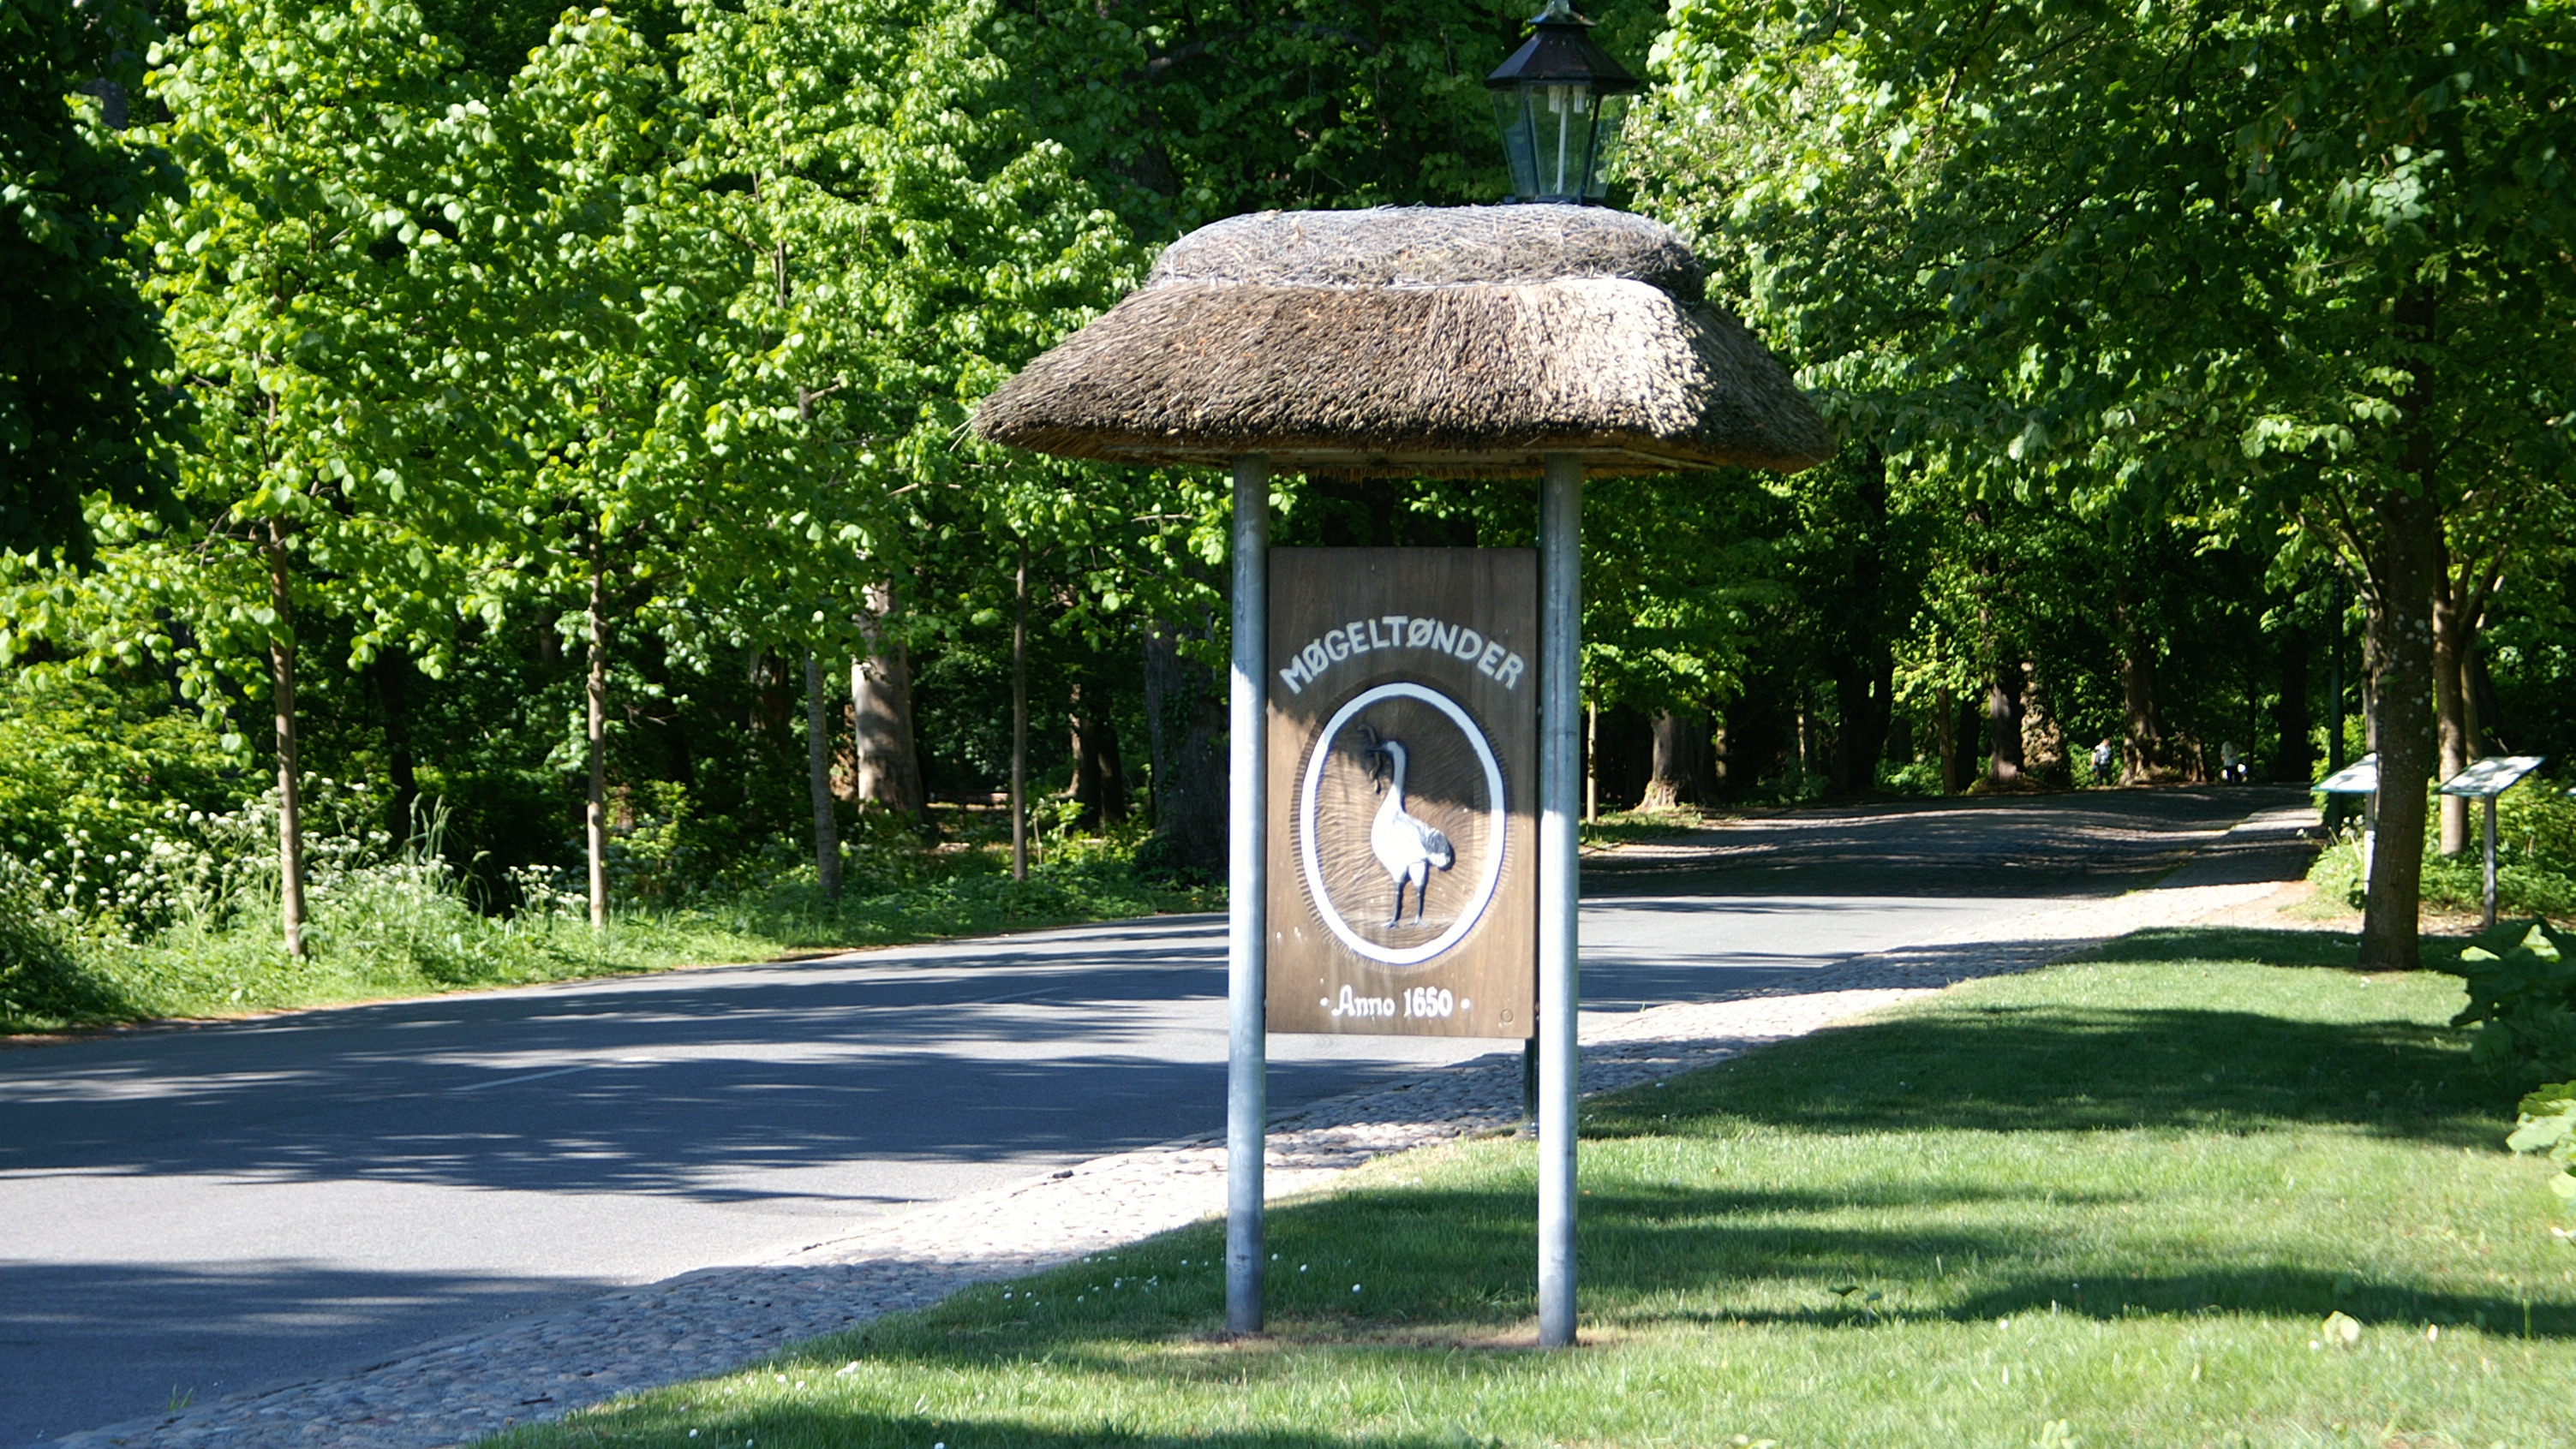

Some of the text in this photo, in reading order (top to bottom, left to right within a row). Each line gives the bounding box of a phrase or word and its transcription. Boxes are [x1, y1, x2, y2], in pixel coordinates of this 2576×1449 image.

[1279, 615, 1525, 695] MØGELTØNDER
[1331, 984, 1453, 1017] Anno 1650
